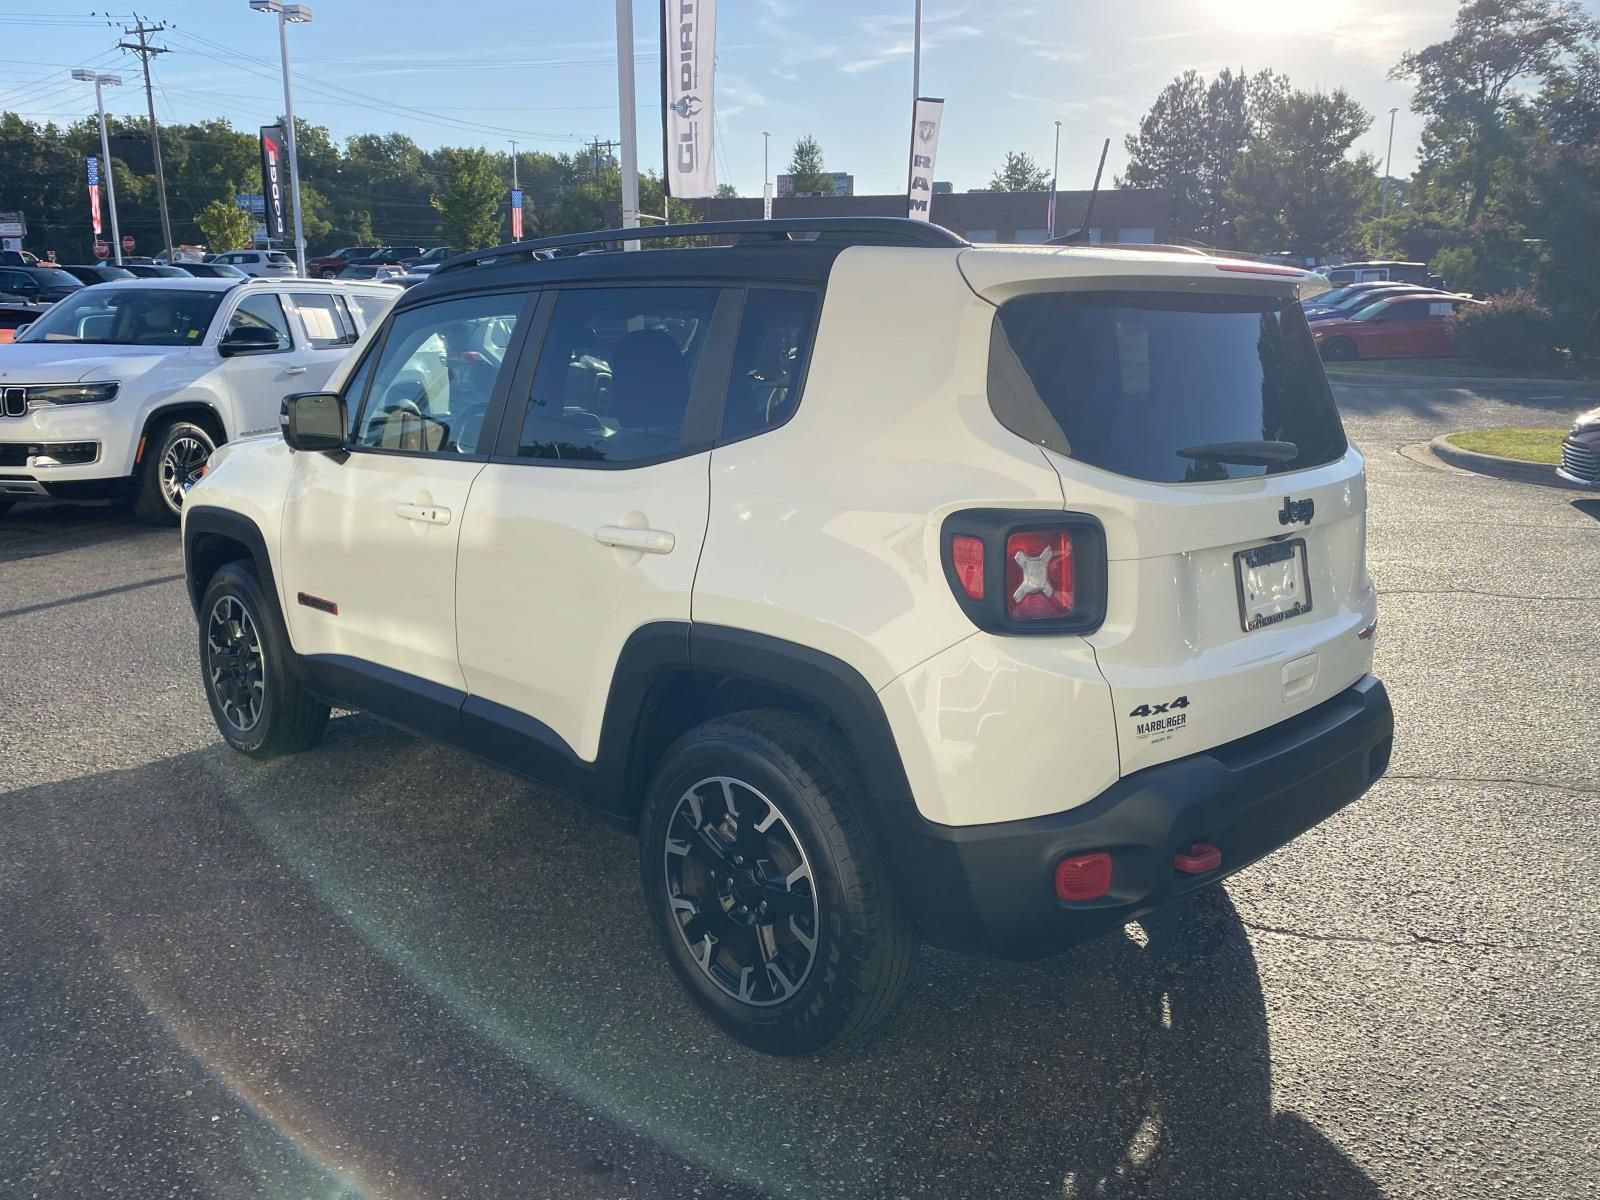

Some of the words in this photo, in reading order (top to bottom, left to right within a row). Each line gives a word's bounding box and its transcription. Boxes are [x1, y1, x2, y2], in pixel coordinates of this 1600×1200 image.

[677, 0, 697, 173] GLDIAT
[269, 150, 284, 233] DODGE
[909, 154, 932, 212] RAM
[1278, 496, 1315, 526] Jeep
[1129, 695, 1190, 717] 4x4
[1136, 713, 1187, 735] MARBURGER
